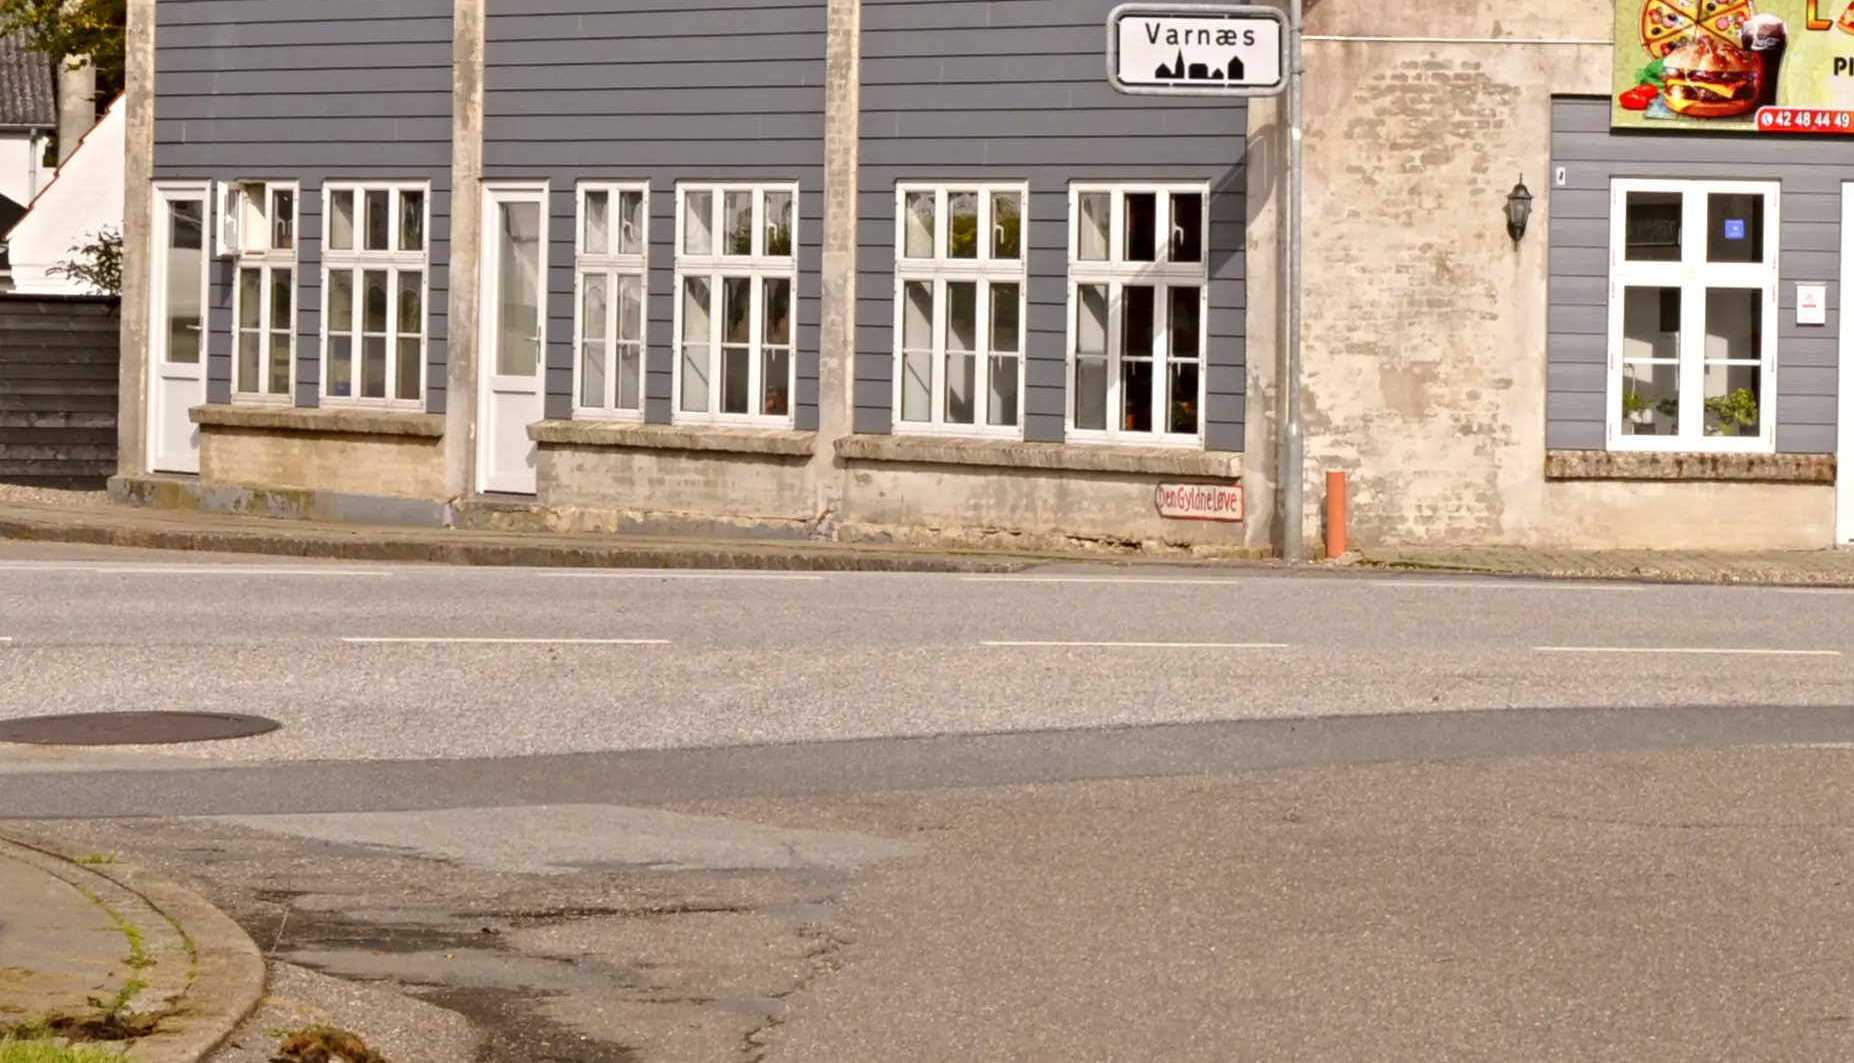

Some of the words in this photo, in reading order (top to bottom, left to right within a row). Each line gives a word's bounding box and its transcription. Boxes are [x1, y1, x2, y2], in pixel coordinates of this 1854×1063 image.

[1145, 22, 1256, 47] Varnæs
[1775, 111, 1791, 126] 42
[1795, 112, 1811, 126] 48
[1814, 112, 1831, 127] 44
[1834, 113, 1850, 127] 49
